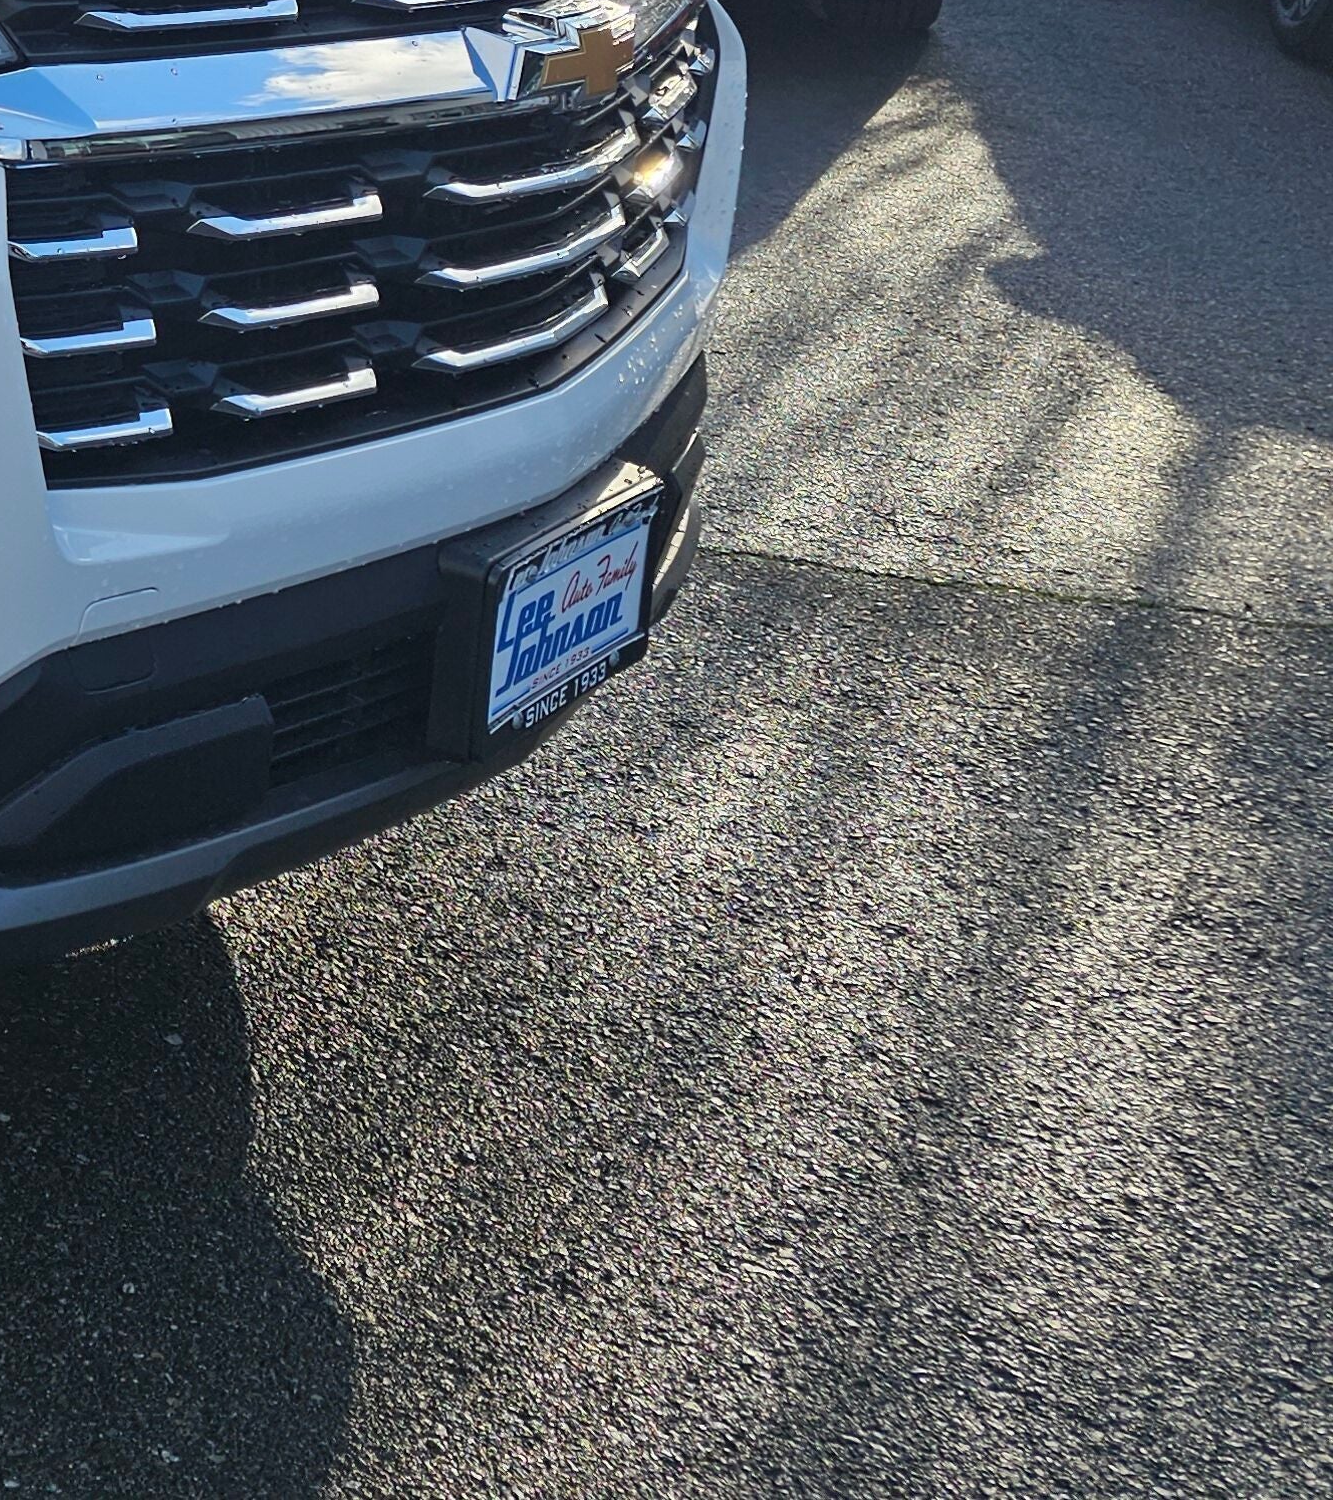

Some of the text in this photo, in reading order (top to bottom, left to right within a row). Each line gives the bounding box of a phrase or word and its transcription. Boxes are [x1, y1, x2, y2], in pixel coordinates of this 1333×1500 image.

[561, 570, 595, 613] Auto
[595, 541, 639, 596] Family
[495, 591, 623, 698] Johnson
[497, 590, 556, 653] Lee
[525, 660, 608, 729] SINCE 1933
[531, 646, 590, 689] SINCE 1933
